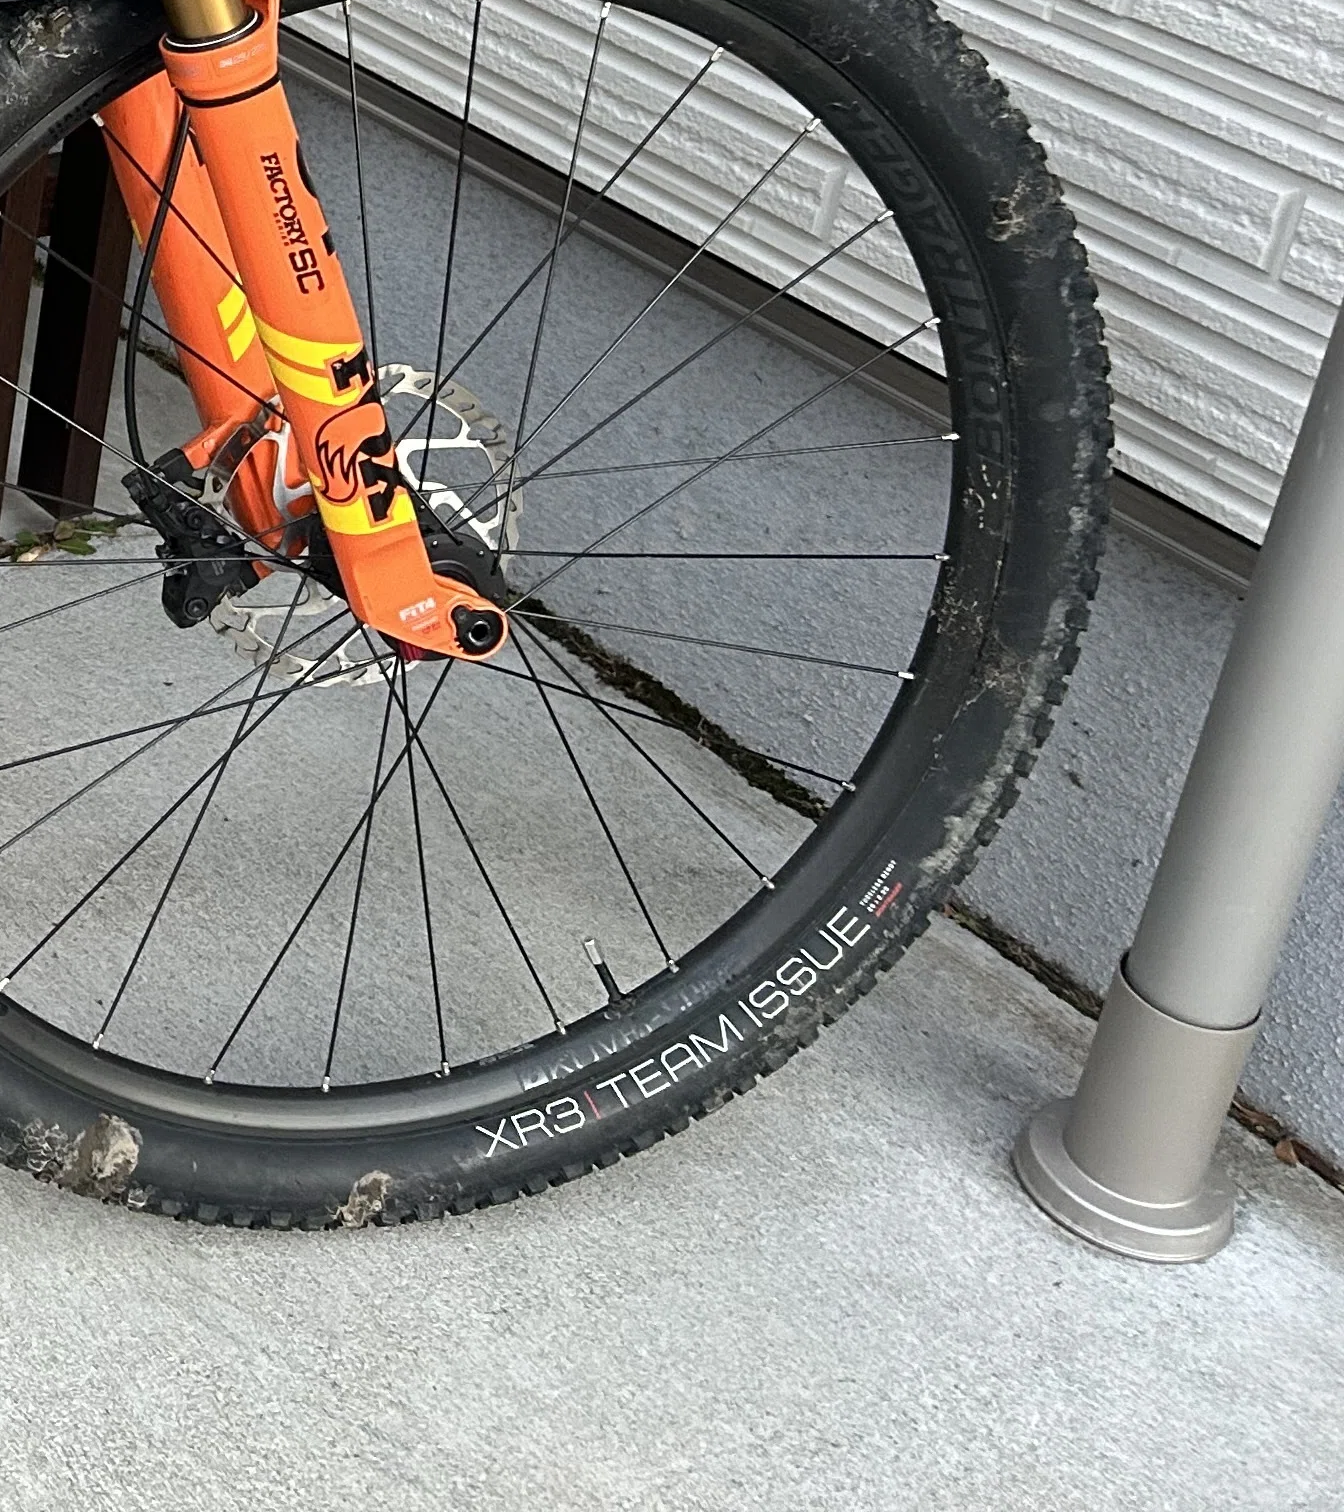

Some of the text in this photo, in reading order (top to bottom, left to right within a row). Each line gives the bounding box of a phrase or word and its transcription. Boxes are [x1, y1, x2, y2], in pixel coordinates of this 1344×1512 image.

[260, 152, 309, 246] FACTORY
[475, 1095, 588, 1159] XR3
[596, 1013, 746, 1110] TEAM
[737, 906, 872, 1029] ISSUE
